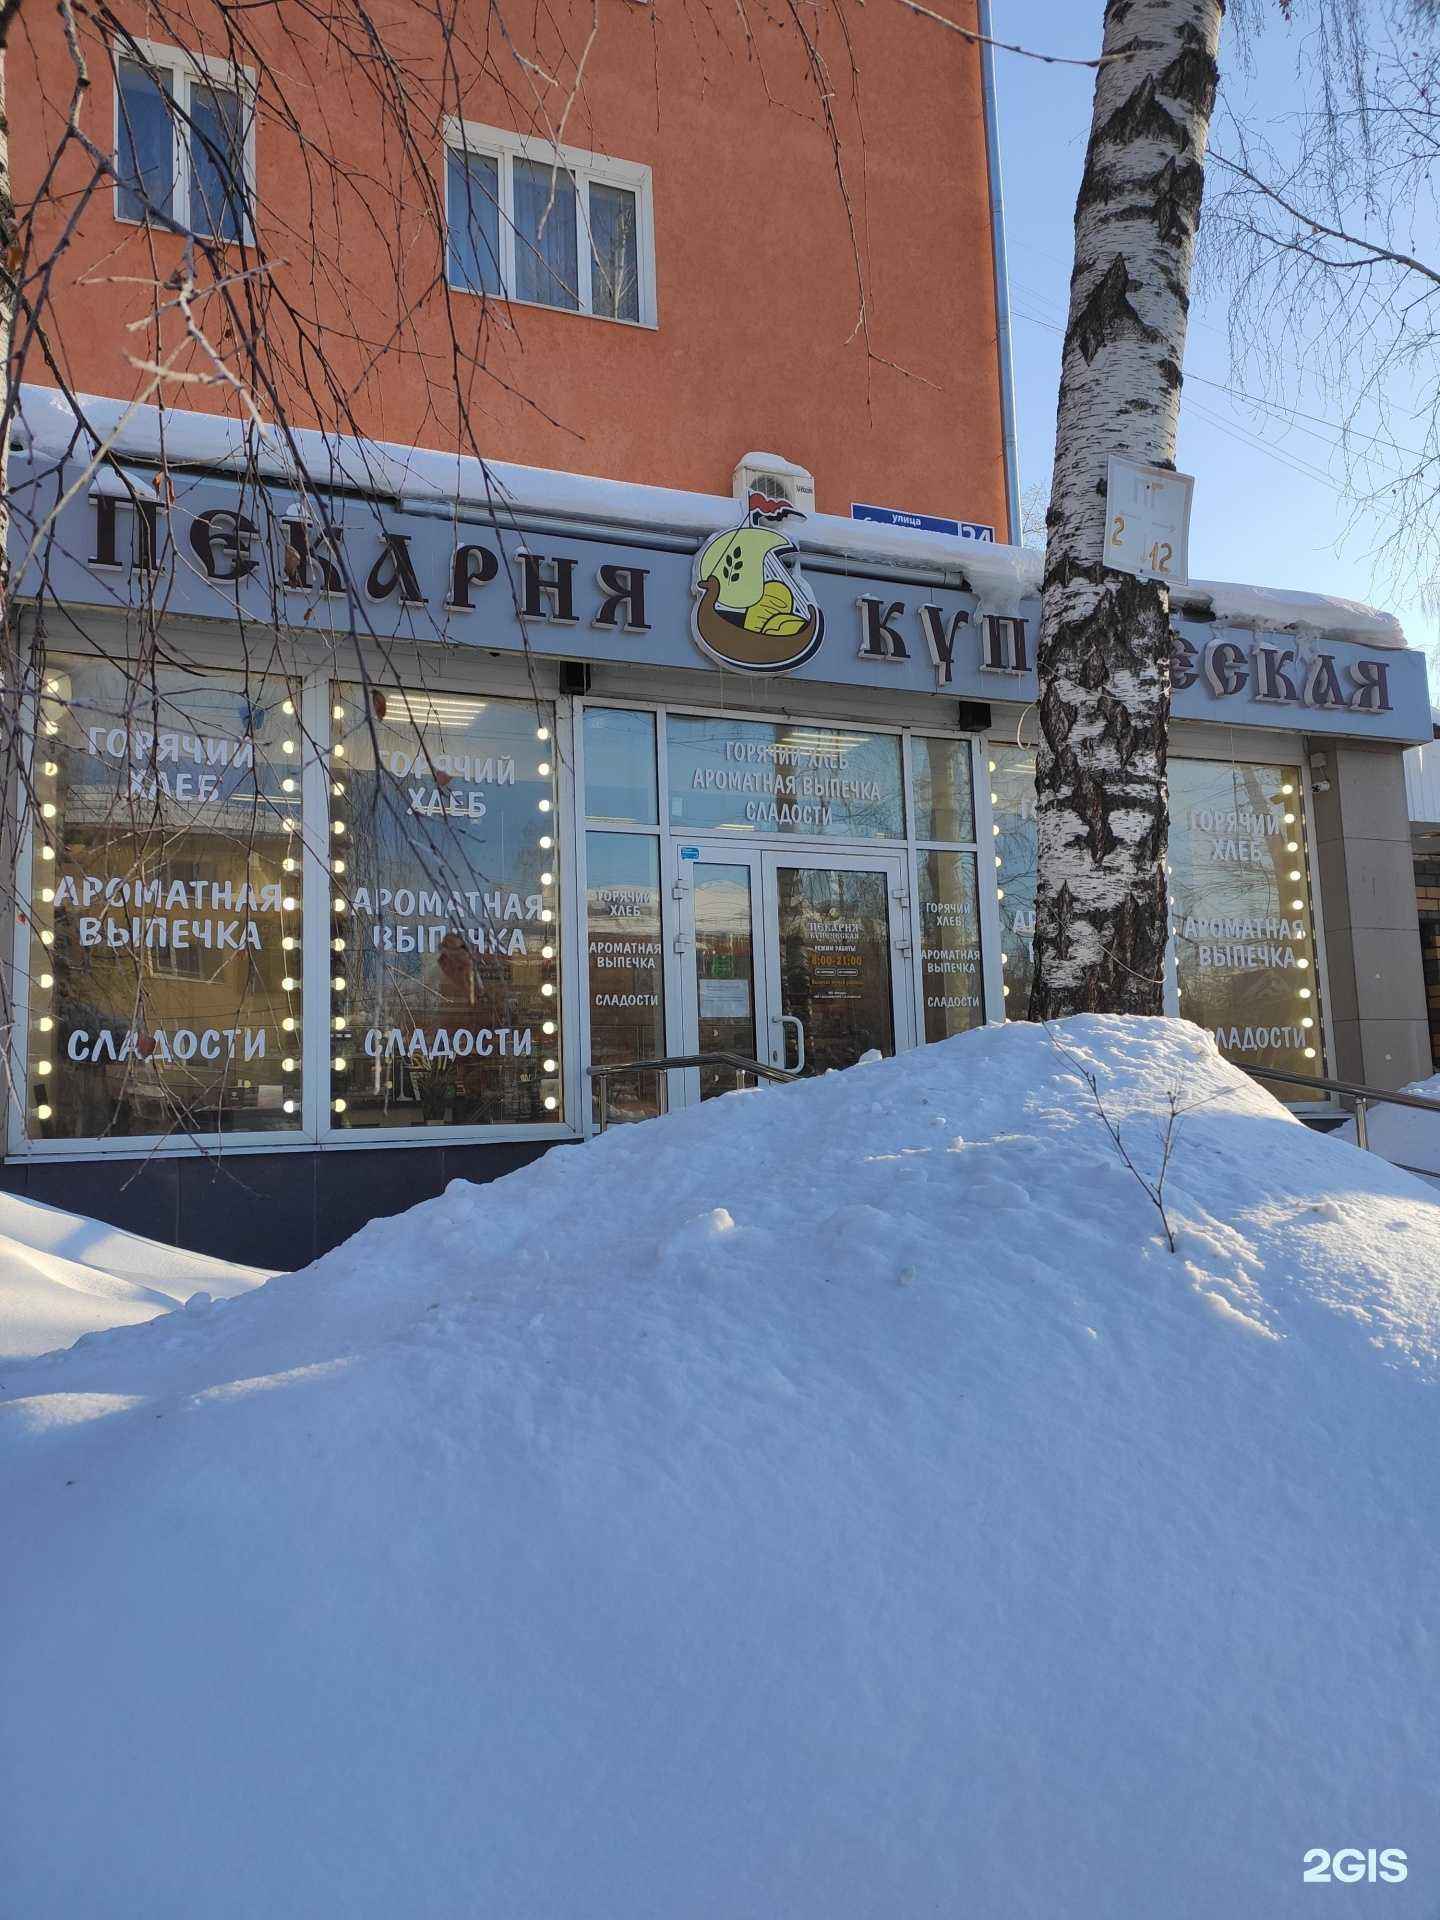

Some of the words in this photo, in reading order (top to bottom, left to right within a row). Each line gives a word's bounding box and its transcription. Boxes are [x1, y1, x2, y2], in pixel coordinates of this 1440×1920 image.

[891, 513, 922, 527] улица
[1110, 516, 1125, 546] 2
[88, 492, 653, 632] ПЕКАРНЯ
[129, 768, 220, 801] ХЛЕБ
[692, 768, 796, 795] АРОМАТНАЯ
[802, 775, 881, 801] ВЫПЕЧКА
[406, 787, 487, 817] ХЛЕБ
[746, 801, 833, 826] СЛАДОСТИ
[53, 876, 282, 911] АРОМАТНАЯ
[352, 888, 544, 921] АРОМАТНАЯ
[610, 905, 641, 917] ХЛЕБ
[936, 915, 962, 927] ХЛЕБ
[79, 916, 262, 950] ВЫПЕЧКА
[1184, 916, 1304, 940] АРОМАТНАЯ
[589, 942, 662, 954] АРОМАТНАЯ
[921, 949, 981, 961] АРОМАТНАЯ
[1200, 945, 1298, 968] ВЫПЕЧКА
[597, 957, 656, 969] ВЫПЕЧКА
[927, 963, 976, 974] ВЫПЕЧКА
[595, 994, 658, 1008] СЛАДОСТИ
[927, 996, 979, 1009] СЛАДОСТИ
[364, 1028, 533, 1060] СЛАДОСТИ
[1214, 1027, 1306, 1051] ЛАДОСТИ
